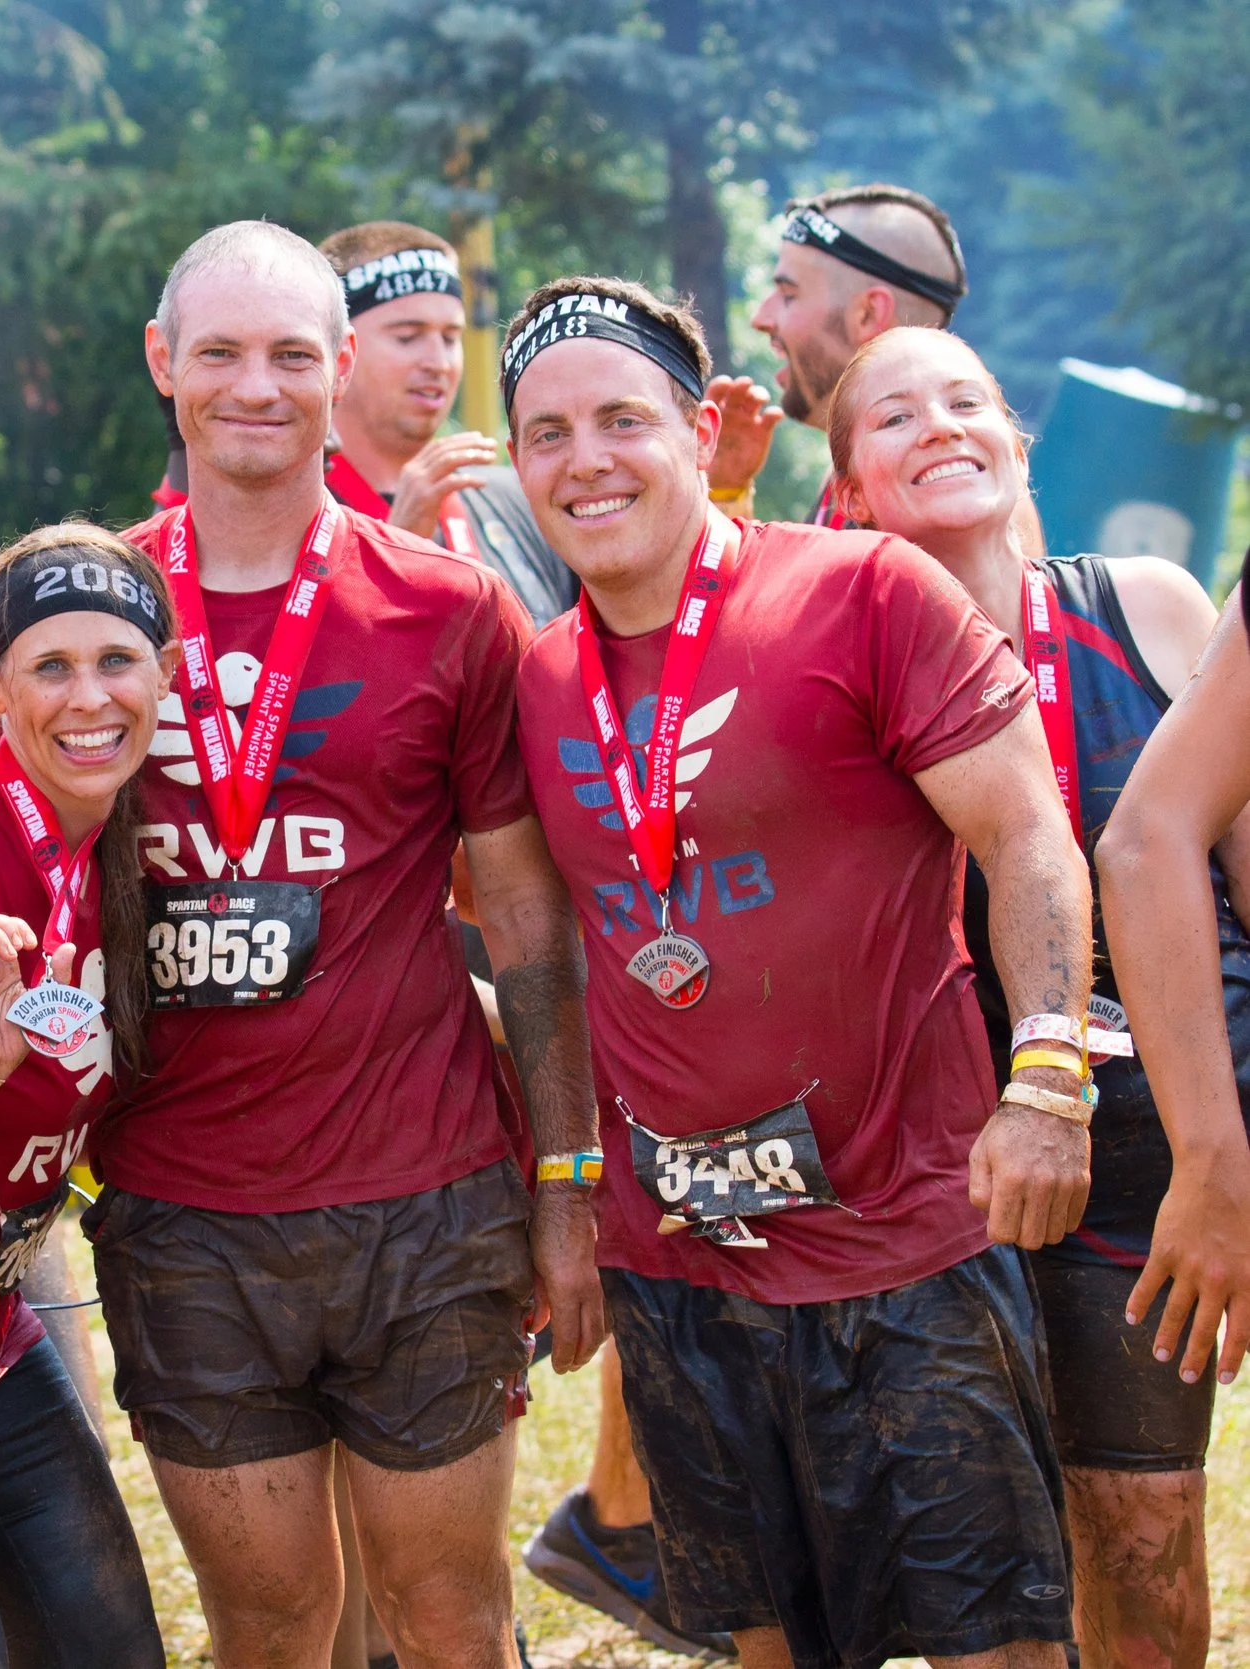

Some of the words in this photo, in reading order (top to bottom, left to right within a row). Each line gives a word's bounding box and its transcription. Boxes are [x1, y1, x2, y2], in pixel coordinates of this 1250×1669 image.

[375, 271, 448, 300] 4847
[297, 579, 318, 618] RACE
[681, 597, 707, 638] RACE
[183, 635, 207, 690] SPRINT
[1036, 664, 1057, 704] RACE
[259, 671, 279, 717] SPRINT
[273, 674, 291, 708] 2014
[667, 696, 682, 731] 2014
[658, 695, 672, 742] SPRINT
[200, 715, 228, 782] SPARTAN
[243, 719, 265, 777] FINISHER
[255, 714, 280, 782] SPARTAN
[649, 747, 662, 808] FINISHER
[659, 738, 673, 808] SPARTAN
[6, 779, 48, 842] SPARTAN
[49, 865, 64, 897] RA
[134, 815, 346, 879] RWB
[167, 899, 208, 912] SPARTAN
[229, 897, 256, 910] RACE
[593, 850, 776, 936] RWB
[147, 919, 291, 989] 3953
[633, 949, 655, 973] 2014
[657, 943, 699, 968] FINISHER
[643, 961, 668, 980] SPARTAN
[14, 996, 39, 1020] 2014
[40, 989, 94, 1013] FINISHER
[29, 1007, 56, 1026] SPARTAN
[57, 1006, 83, 1021] SPRINT
[1088, 1000, 1123, 1024] ISHER
[655, 1139, 806, 1202] 3448
